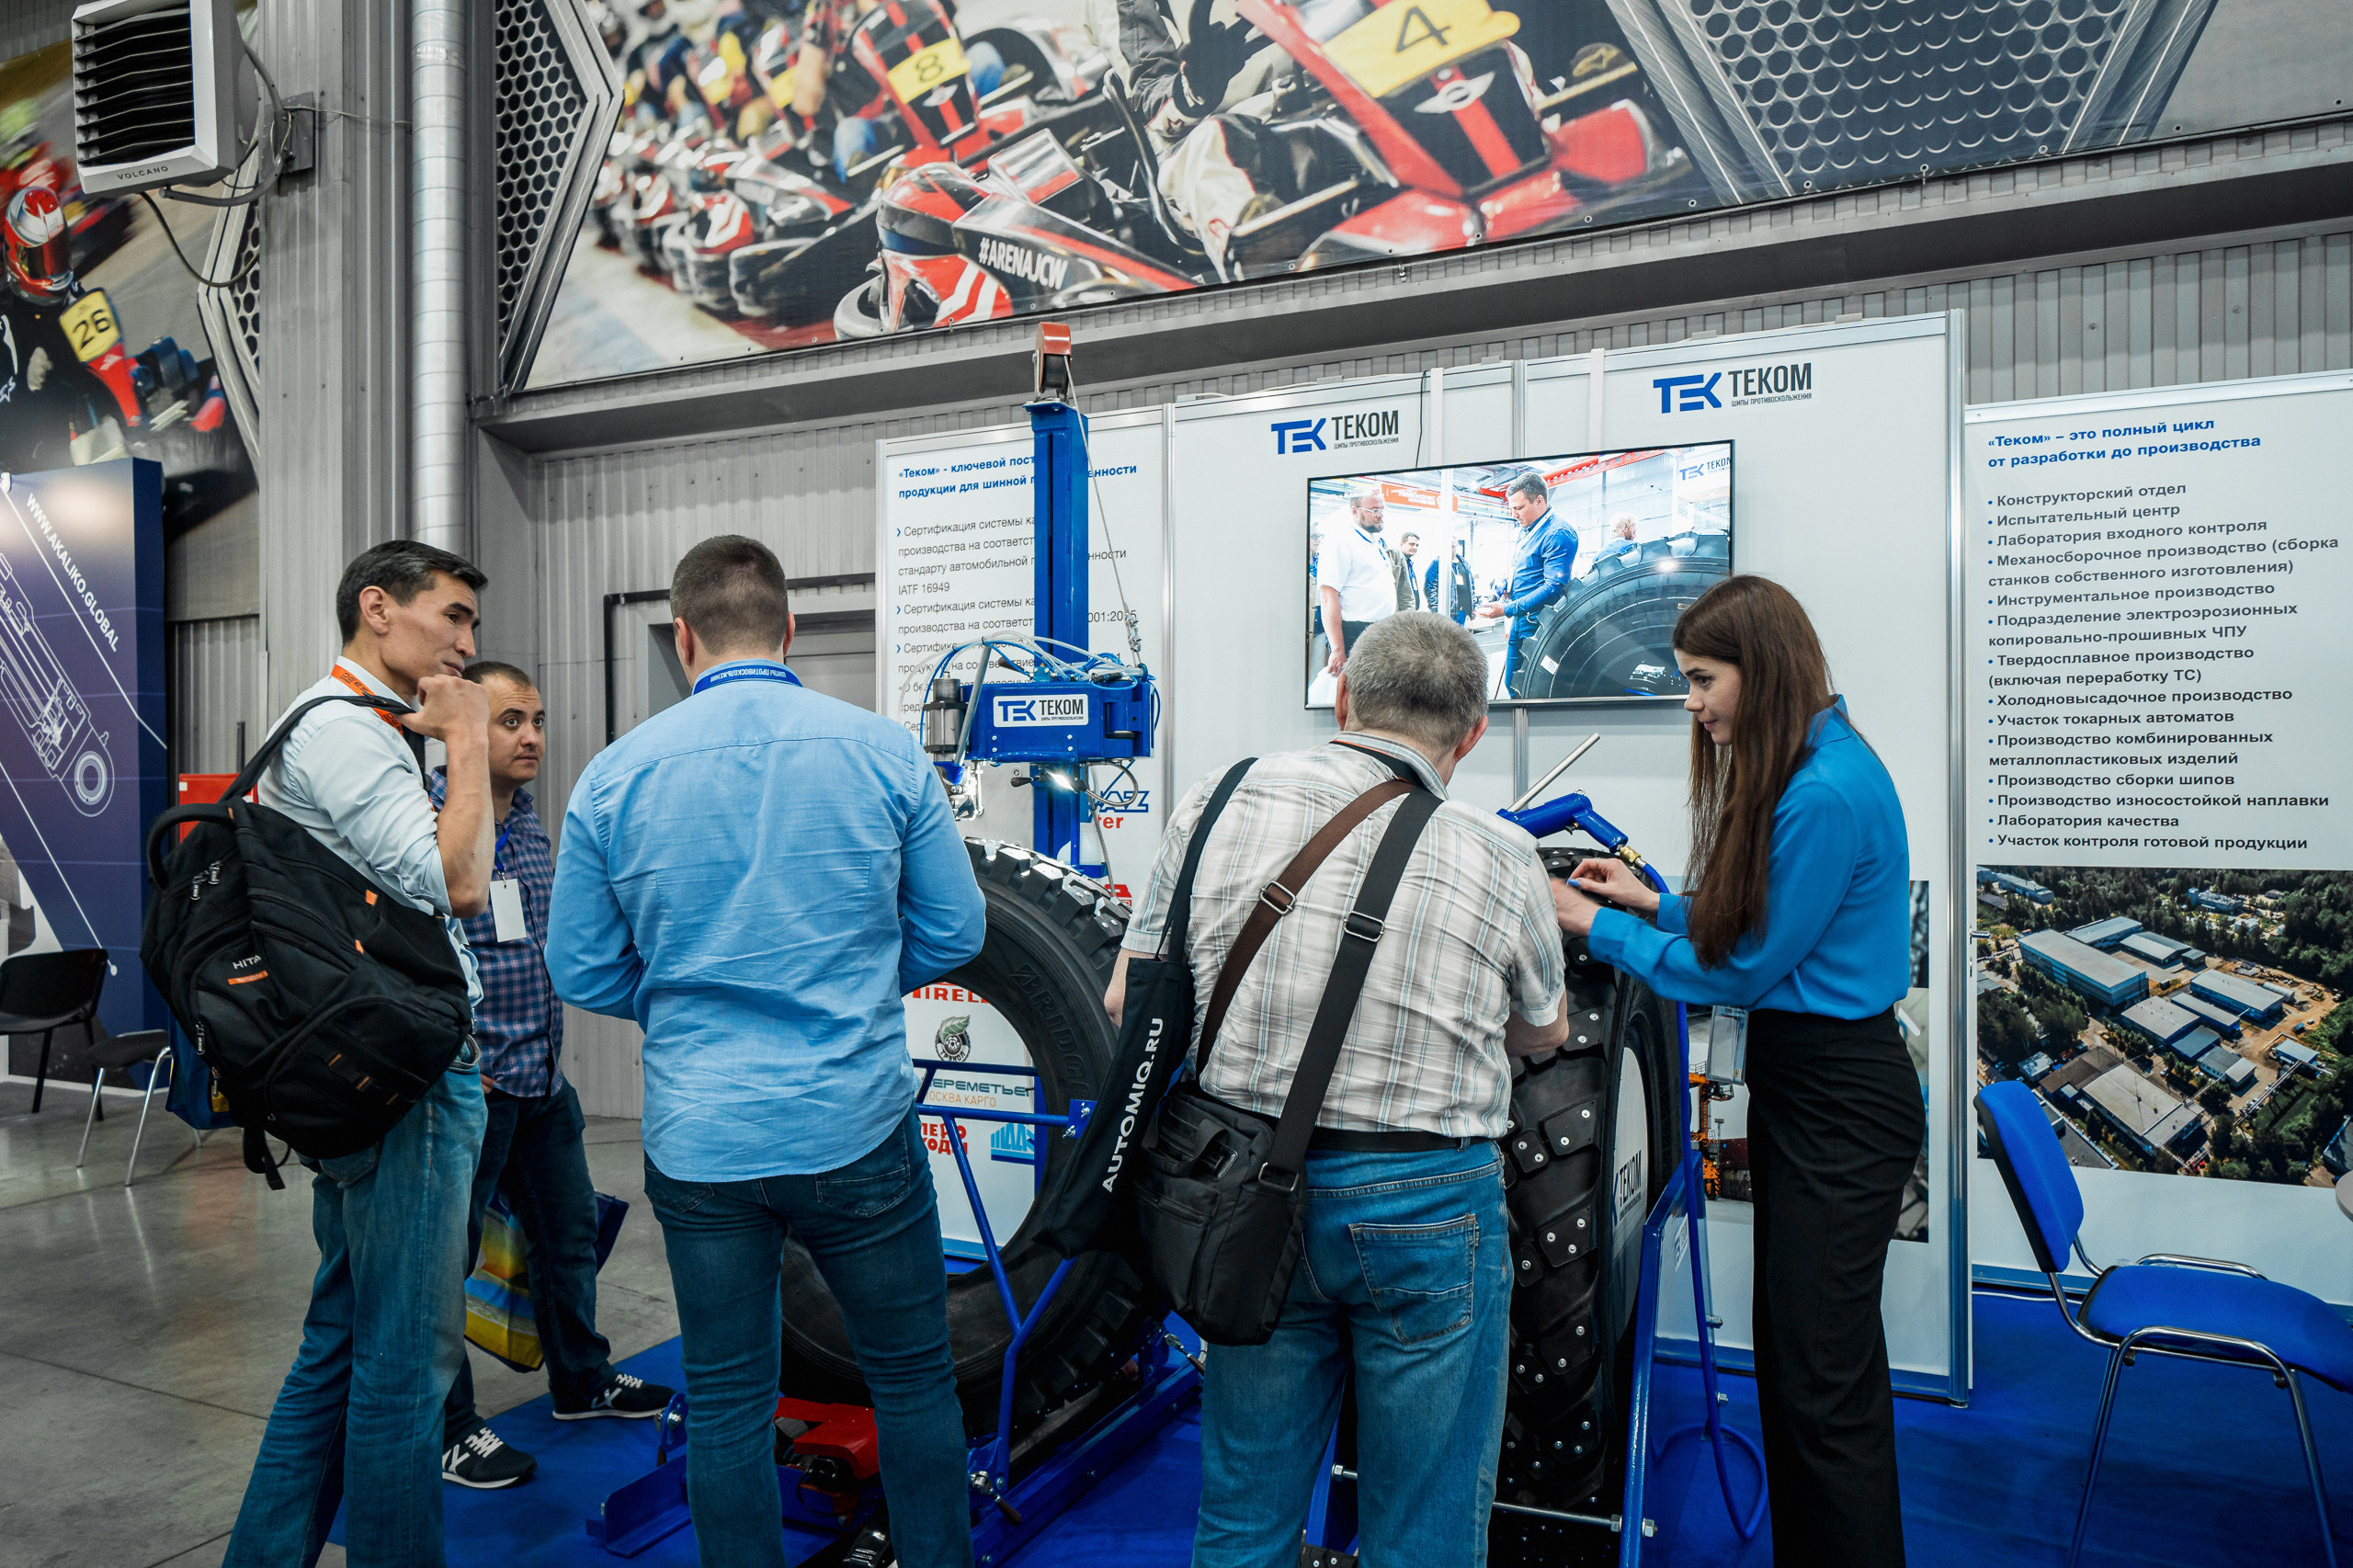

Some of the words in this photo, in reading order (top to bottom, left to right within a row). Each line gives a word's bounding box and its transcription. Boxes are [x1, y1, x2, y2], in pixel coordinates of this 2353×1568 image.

[1395, 6, 1450, 52] 4
[915, 55, 944, 82] 8
[117, 165, 168, 180] VOLCANO
[978, 236, 1068, 290] #ARENAJCW
[72, 308, 110, 350] 26
[1727, 362, 1812, 397] ТЕКОМ
[1731, 399, 1749, 407] ШИПЫ
[1750, 392, 1813, 405] ПРОТИВОСКОЛЬЖЕНИЯ
[1331, 410, 1399, 440] ТЕКОМ
[1987, 435, 2052, 448] «Теком»
[2068, 429, 2097, 441] это
[2101, 421, 2168, 438] полный
[2172, 419, 2215, 434] цикл
[1349, 437, 1399, 448] ПРОТИВОСКОЛЬЖЕНИЯ
[1987, 458, 2006, 468] от
[2010, 449, 2107, 469] разработки
[2110, 448, 2132, 460] до
[2137, 437, 2262, 458] производства
[898, 465, 940, 479] «Теком»
[949, 456, 1006, 473] ключевой
[898, 484, 957, 501] продукции
[959, 482, 980, 494] для
[982, 473, 1028, 490] шинной
[1997, 485, 2133, 507] Конструкторский
[2138, 484, 2187, 498] отдел
[904, 521, 977, 538] Сертификация
[978, 517, 1023, 530] системы
[1997, 506, 2128, 527] Испытательный
[2132, 506, 2181, 519] центр
[1995, 531, 2102, 547] Лаборатория
[2106, 527, 2184, 540] входного
[2188, 521, 2268, 536] контроля
[898, 542, 966, 559] производства
[968, 541, 981, 551] на
[983, 536, 1035, 550] соответст
[1997, 549, 2143, 567] Механосборочное
[2146, 542, 2268, 561] производство
[2271, 538, 2339, 554] (сборка
[27, 492, 119, 653] WWW.AKALIKO.GLOBAL
[898, 564, 948, 576] стандарту
[949, 554, 1029, 573] автомобильной
[1988, 574, 2051, 587] станков
[2054, 569, 2166, 584] собственного
[2171, 559, 2294, 578] изготовления)
[898, 584, 919, 596] IATF
[921, 581, 950, 594] 16949
[1997, 590, 2150, 608] Инструментальное
[2154, 584, 2276, 602] производство
[904, 601, 976, 617] Сертификация
[978, 598, 1023, 609] системы
[1997, 612, 2122, 628] Подразделение
[2126, 604, 2299, 622] электроэрозионных
[898, 622, 966, 637] производства
[968, 620, 981, 630] на
[982, 618, 1034, 630] соответст
[1988, 629, 2207, 648] копировально-прошивных
[2211, 624, 2247, 639] ЧПУ
[1996, 653, 2131, 668] Твердосплавное
[2135, 648, 2255, 665] производство
[1988, 675, 2062, 690] (включая
[2065, 670, 2169, 687] переработку
[2173, 668, 2202, 684] ТС)
[1039, 699, 1084, 715] ТЕКОМ
[1996, 693, 2167, 708] Холодновысадочное
[2171, 690, 2293, 705] производство
[1996, 714, 2060, 726] Участок
[2062, 714, 2143, 727] токарных
[2145, 712, 2235, 723] автоматов
[1997, 734, 2111, 749] Производство
[2116, 731, 2274, 747] комбинированных
[1988, 755, 2163, 767] металлопластиковых
[2167, 751, 2239, 767] изделий
[1997, 774, 2111, 789] Производство
[2115, 773, 2174, 789] сборки
[2179, 776, 2235, 786] шипов
[1997, 793, 2112, 809] Производство
[2116, 793, 2242, 806] износостойкой
[2246, 797, 2330, 807] наплавки
[1996, 813, 2102, 829] Лаборатория
[2107, 817, 2179, 827] качества
[1997, 834, 2060, 846] Участок
[2063, 837, 2139, 850] контроля
[2143, 835, 2210, 848] готовой
[2214, 838, 2308, 852] продукции
[232, 954, 262, 970] HITA
[1009, 962, 1091, 1100] BRIDGE
[928, 1078, 1029, 1097] ЕРЕМЕТЬЕ
[964, 1095, 997, 1108] КАРГО
[1102, 1017, 1164, 1194] AUTOMIQ.RU
